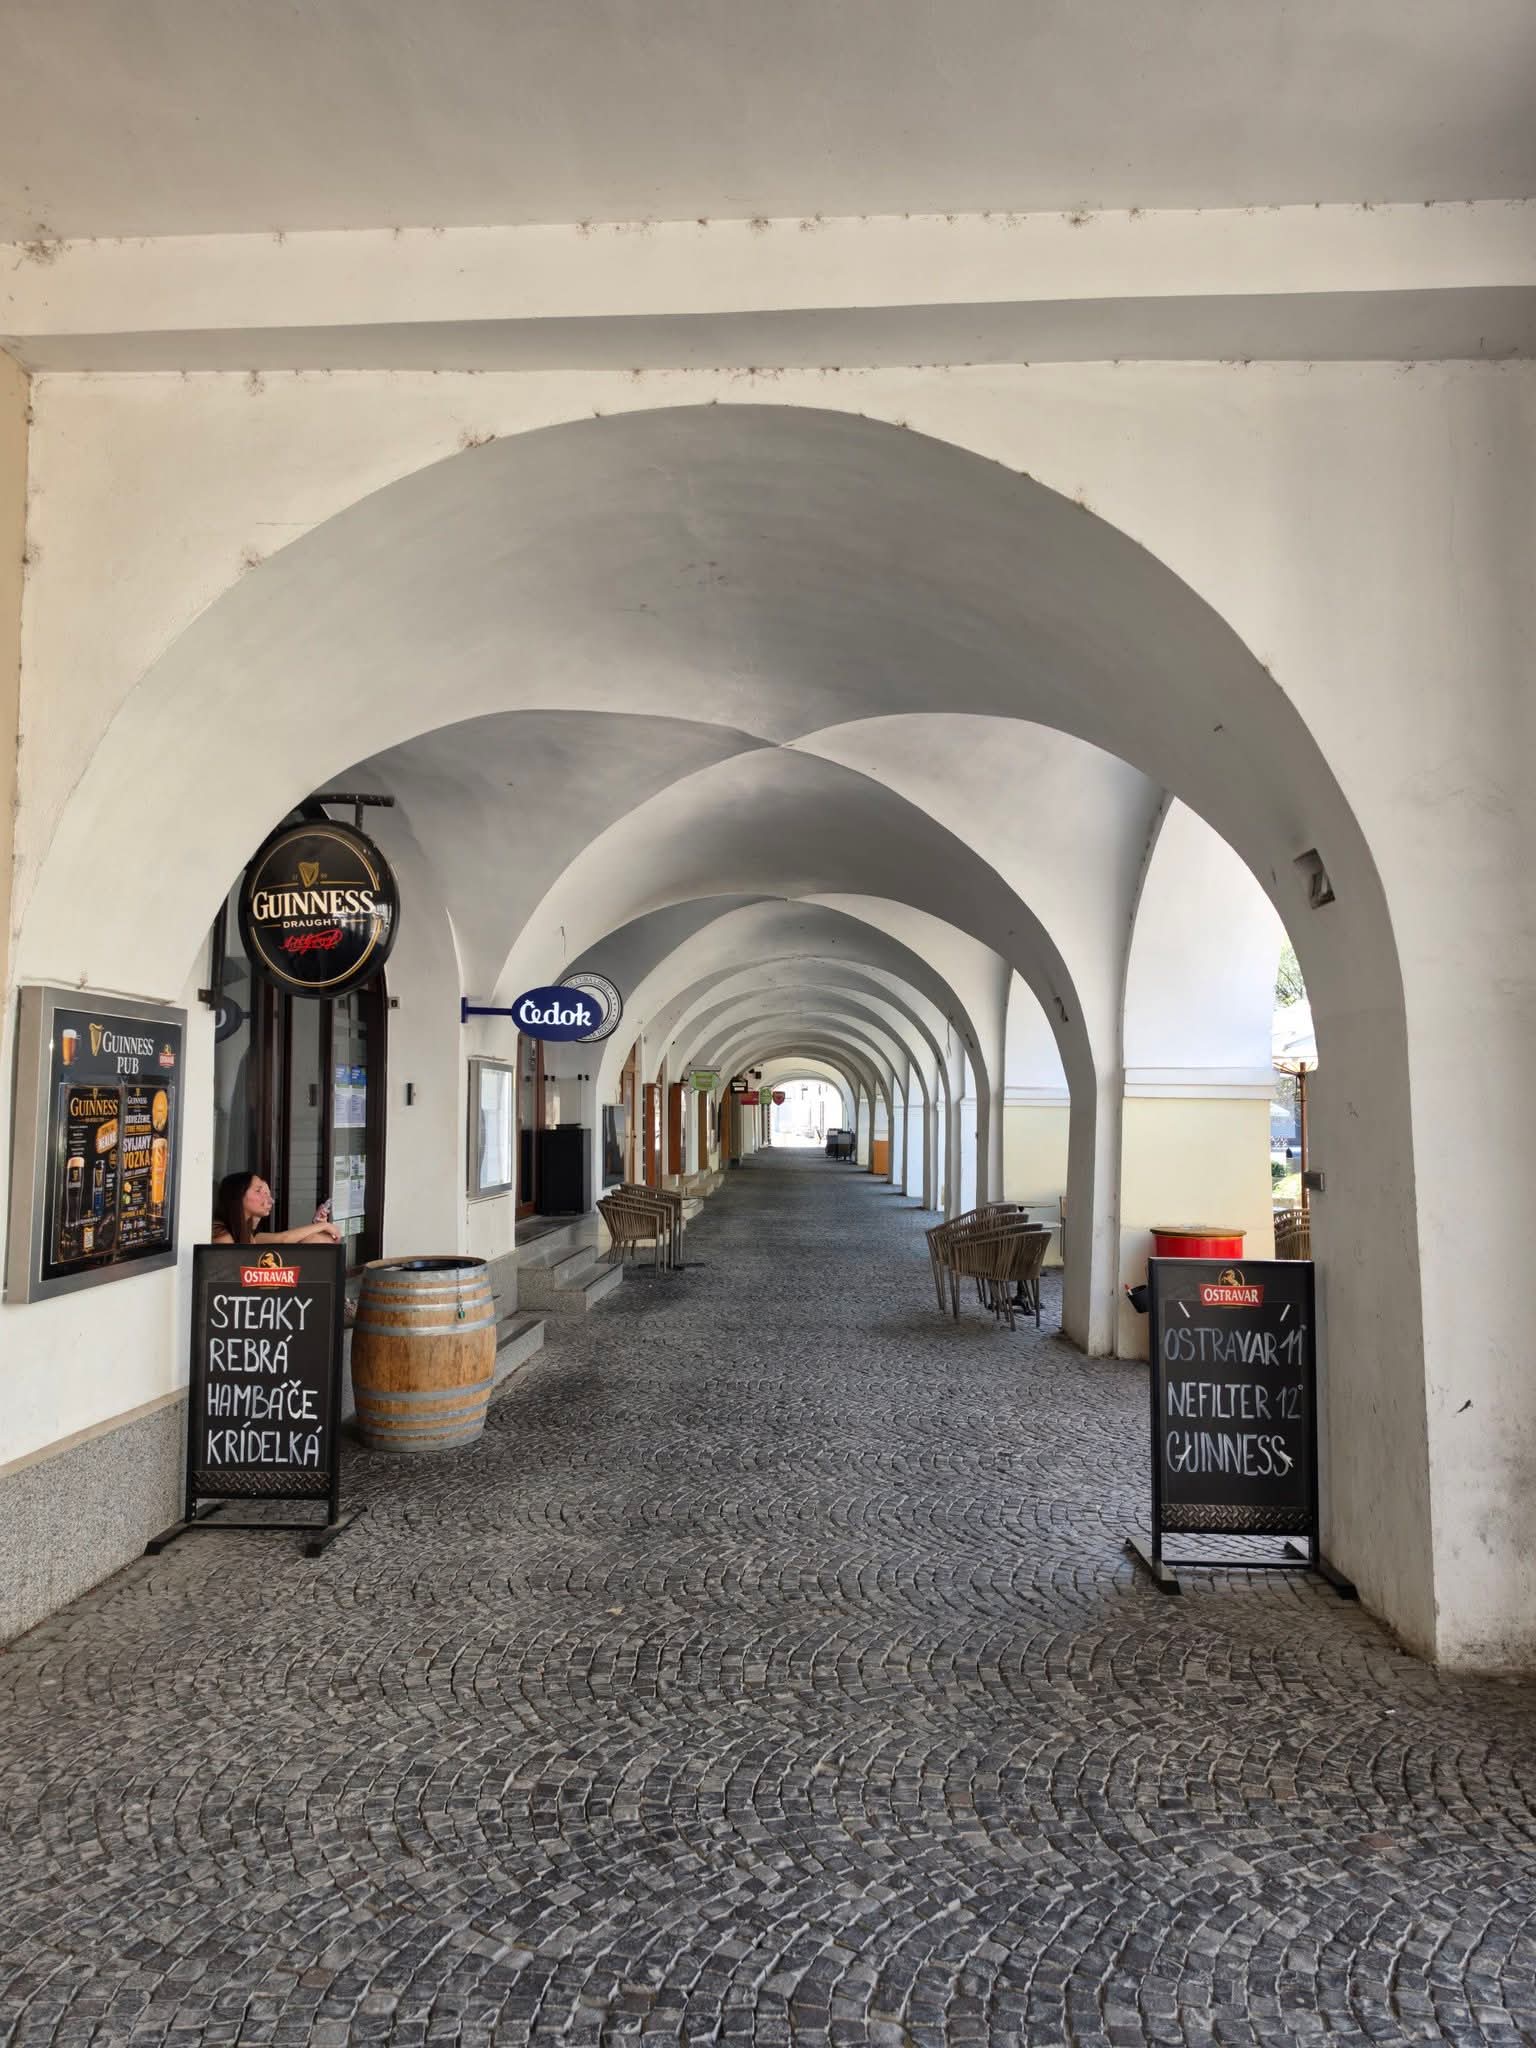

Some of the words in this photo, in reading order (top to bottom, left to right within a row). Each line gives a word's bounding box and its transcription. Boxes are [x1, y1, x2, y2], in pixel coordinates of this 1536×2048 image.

[252, 890, 376, 920] GUINNESS
[282, 918, 339, 929] DRAUGHT
[519, 1000, 592, 1026] Čedok
[102, 1031, 154, 1056] GUINNESS
[116, 1056, 139, 1074] PUB
[70, 1097, 119, 1117] GUINNESS
[243, 1269, 296, 1284] OSTRAVAR
[1203, 1287, 1259, 1303] OSTRAVAR
[210, 1294, 313, 1331] STEAKY
[209, 1334, 293, 1374] REBRÁ
[1164, 1327, 1280, 1366] OSTRAVAR
[207, 1379, 319, 1420] HAMBÁČE
[1167, 1381, 1272, 1420] NEFILTER
[206, 1420, 323, 1467] KRÍDELKÁ
[1166, 1430, 1290, 1477] GUINNESS
